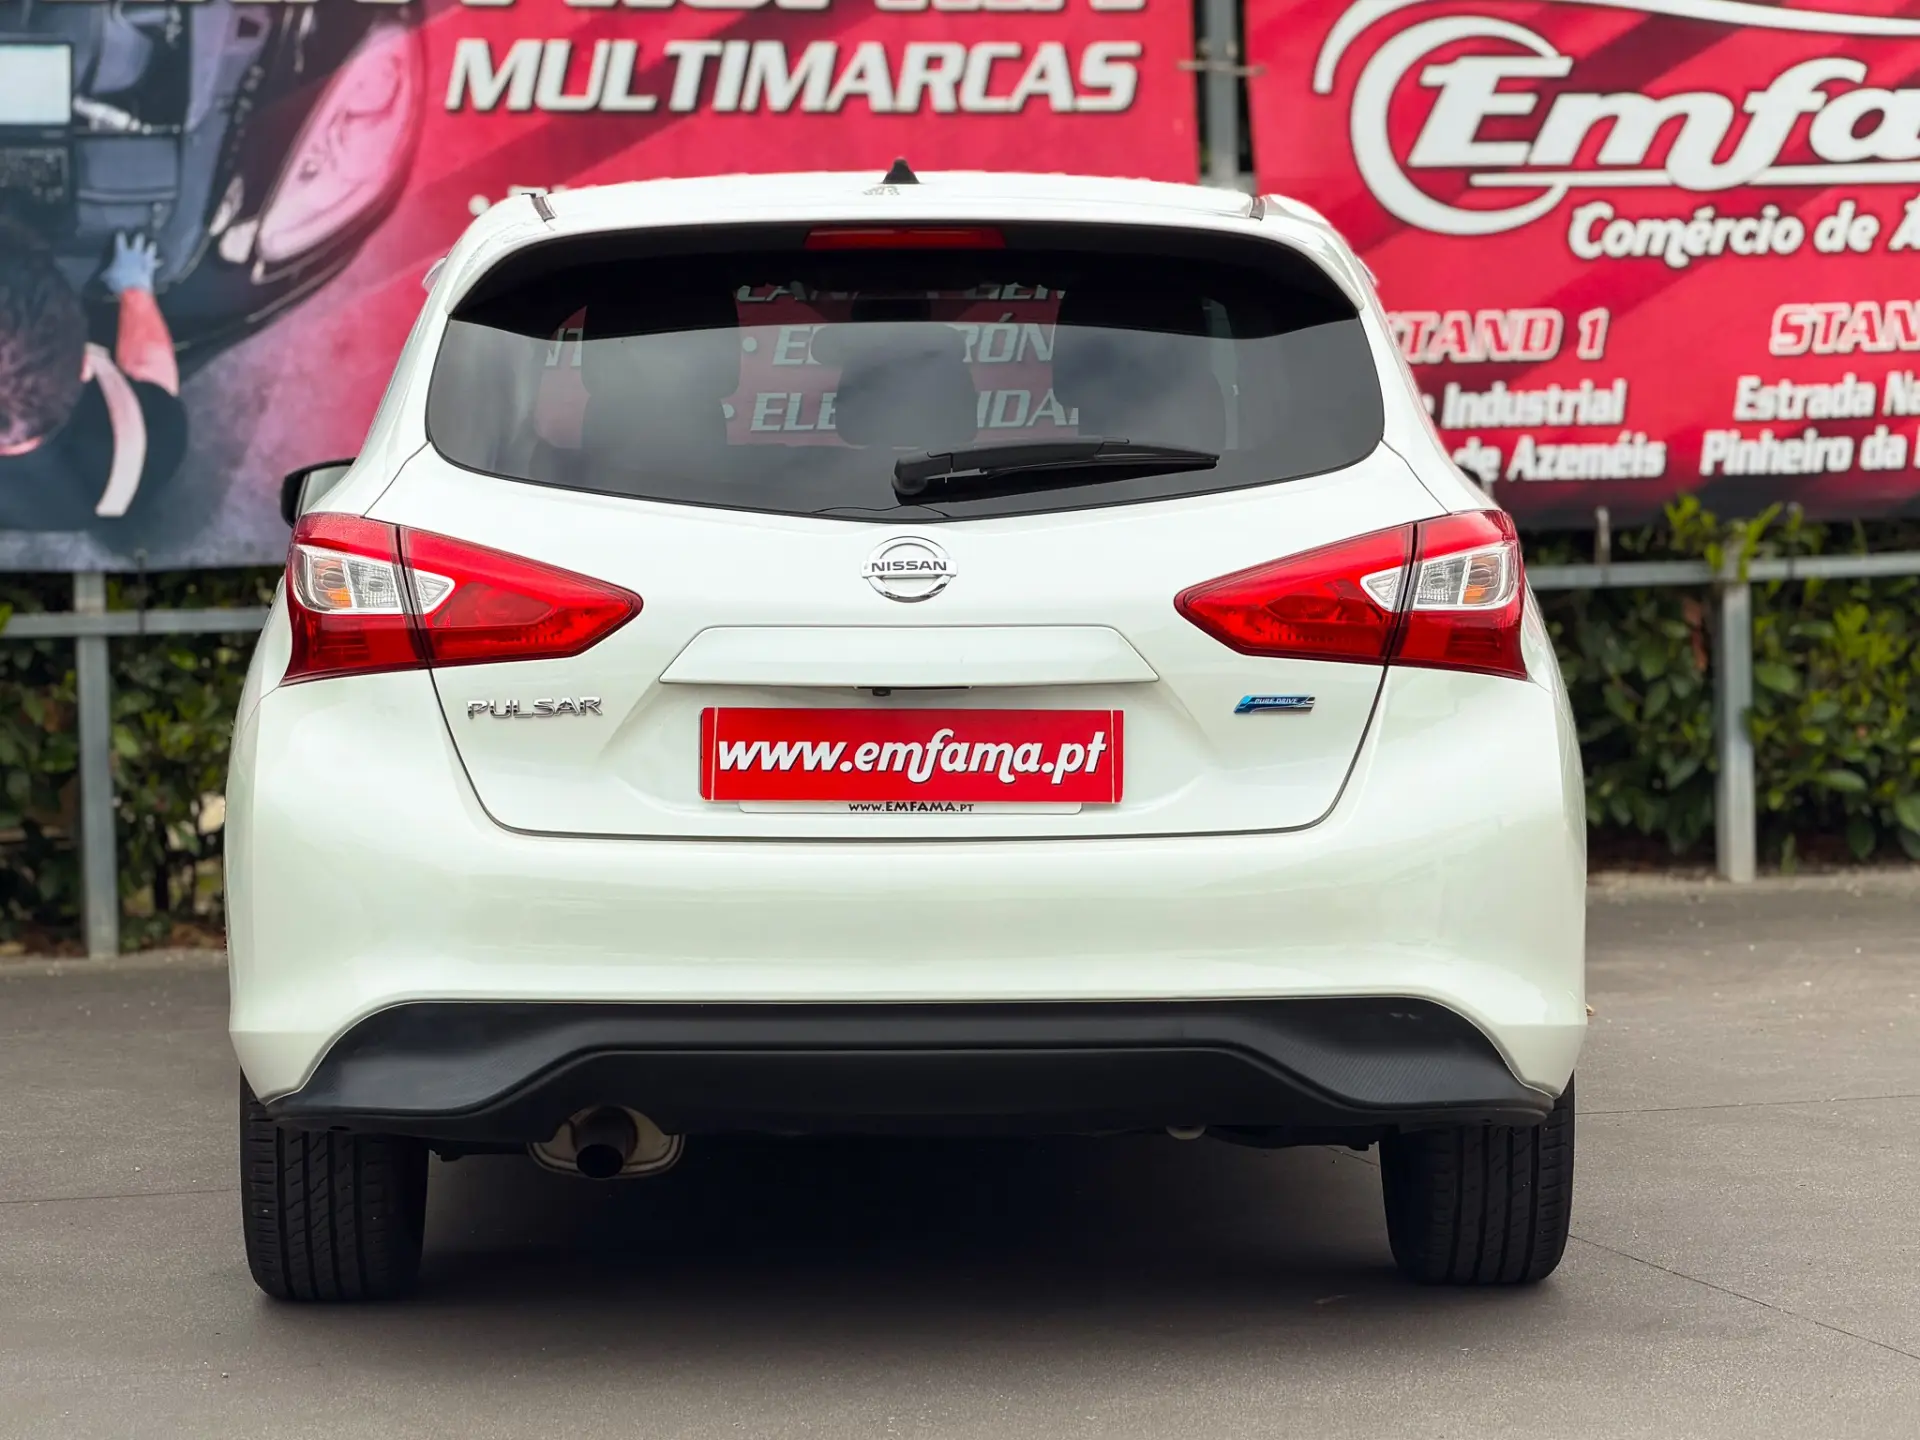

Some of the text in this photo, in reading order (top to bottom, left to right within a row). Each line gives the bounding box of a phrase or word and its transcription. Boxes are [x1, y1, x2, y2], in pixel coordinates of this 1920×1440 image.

[445, 38, 1143, 112] MULTIMARCAS
[1568, 201, 1805, 268] Comércio
[1814, 199, 1880, 252] de
[1388, 306, 1610, 364] TAND 1
[1768, 300, 1920, 356] STAN
[1440, 377, 1628, 430] Industrial
[1732, 371, 1876, 421] Estrada
[1506, 430, 1667, 482] Azeméis
[1699, 427, 1854, 476] Pinheiro
[1859, 424, 1908, 471] da
[871, 561, 947, 573] NISSAN
[467, 696, 603, 719] PULSAR
[718, 728, 1107, 785] www.emfama.pt
